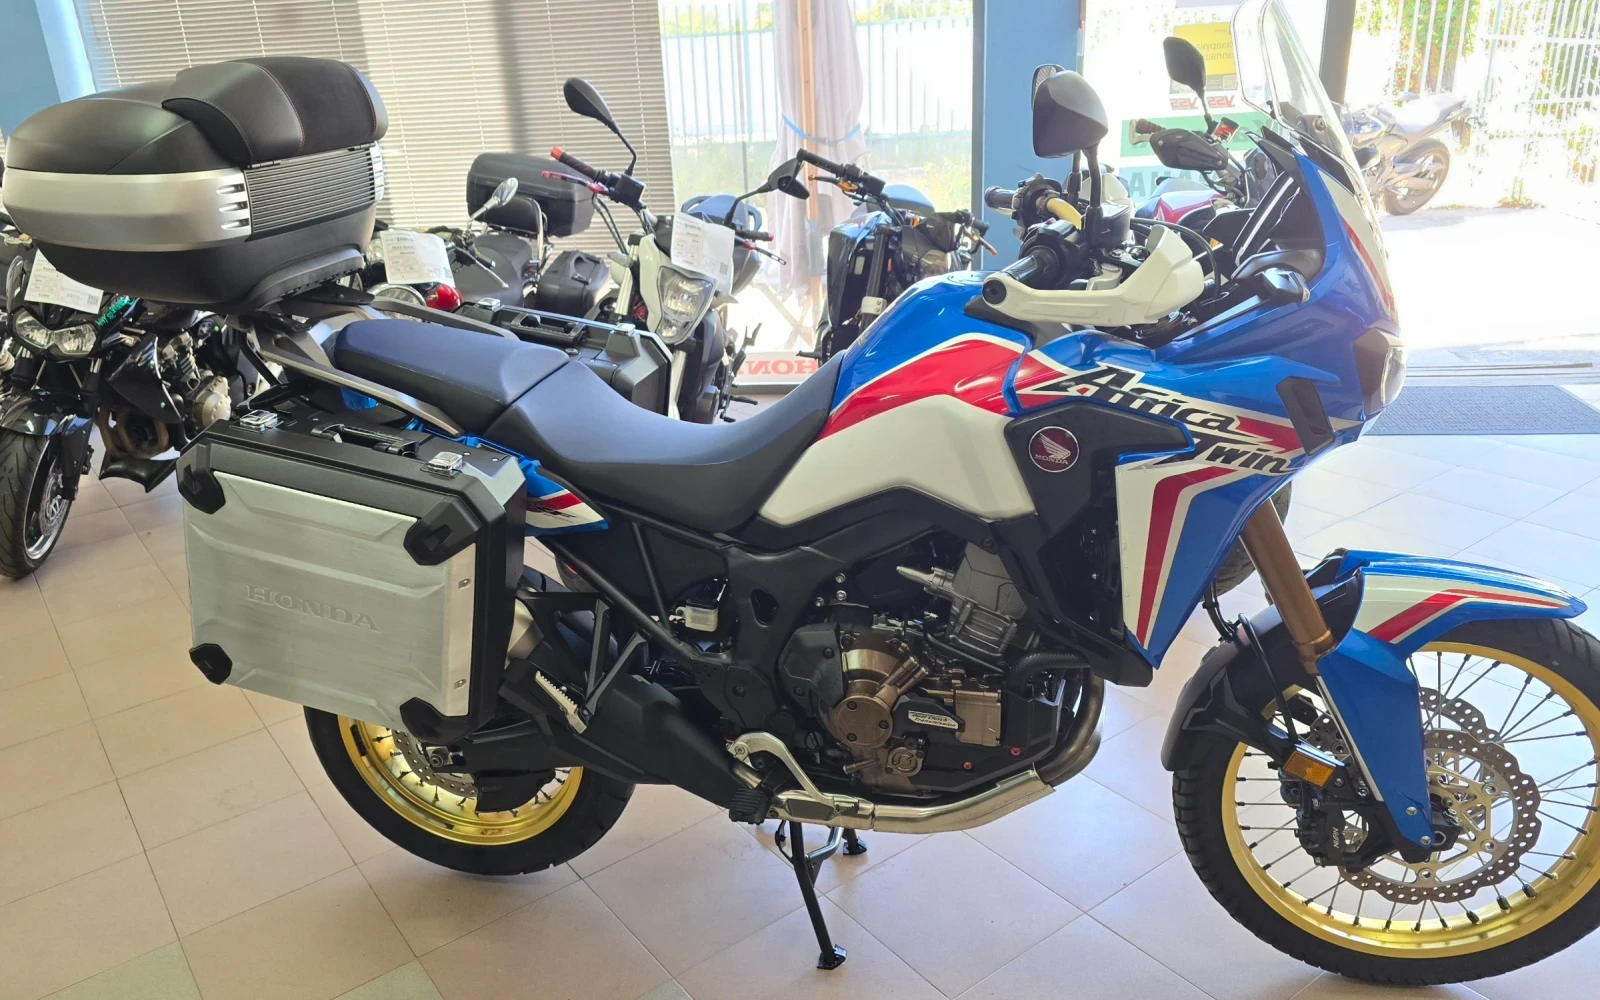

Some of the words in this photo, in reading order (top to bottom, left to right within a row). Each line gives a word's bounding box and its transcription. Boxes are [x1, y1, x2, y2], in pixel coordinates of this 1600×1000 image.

[1031, 365, 1258, 440] Africa
[1034, 454, 1069, 465] HONDA
[1152, 430, 1297, 473] Twin
[245, 584, 381, 633] HONDA
